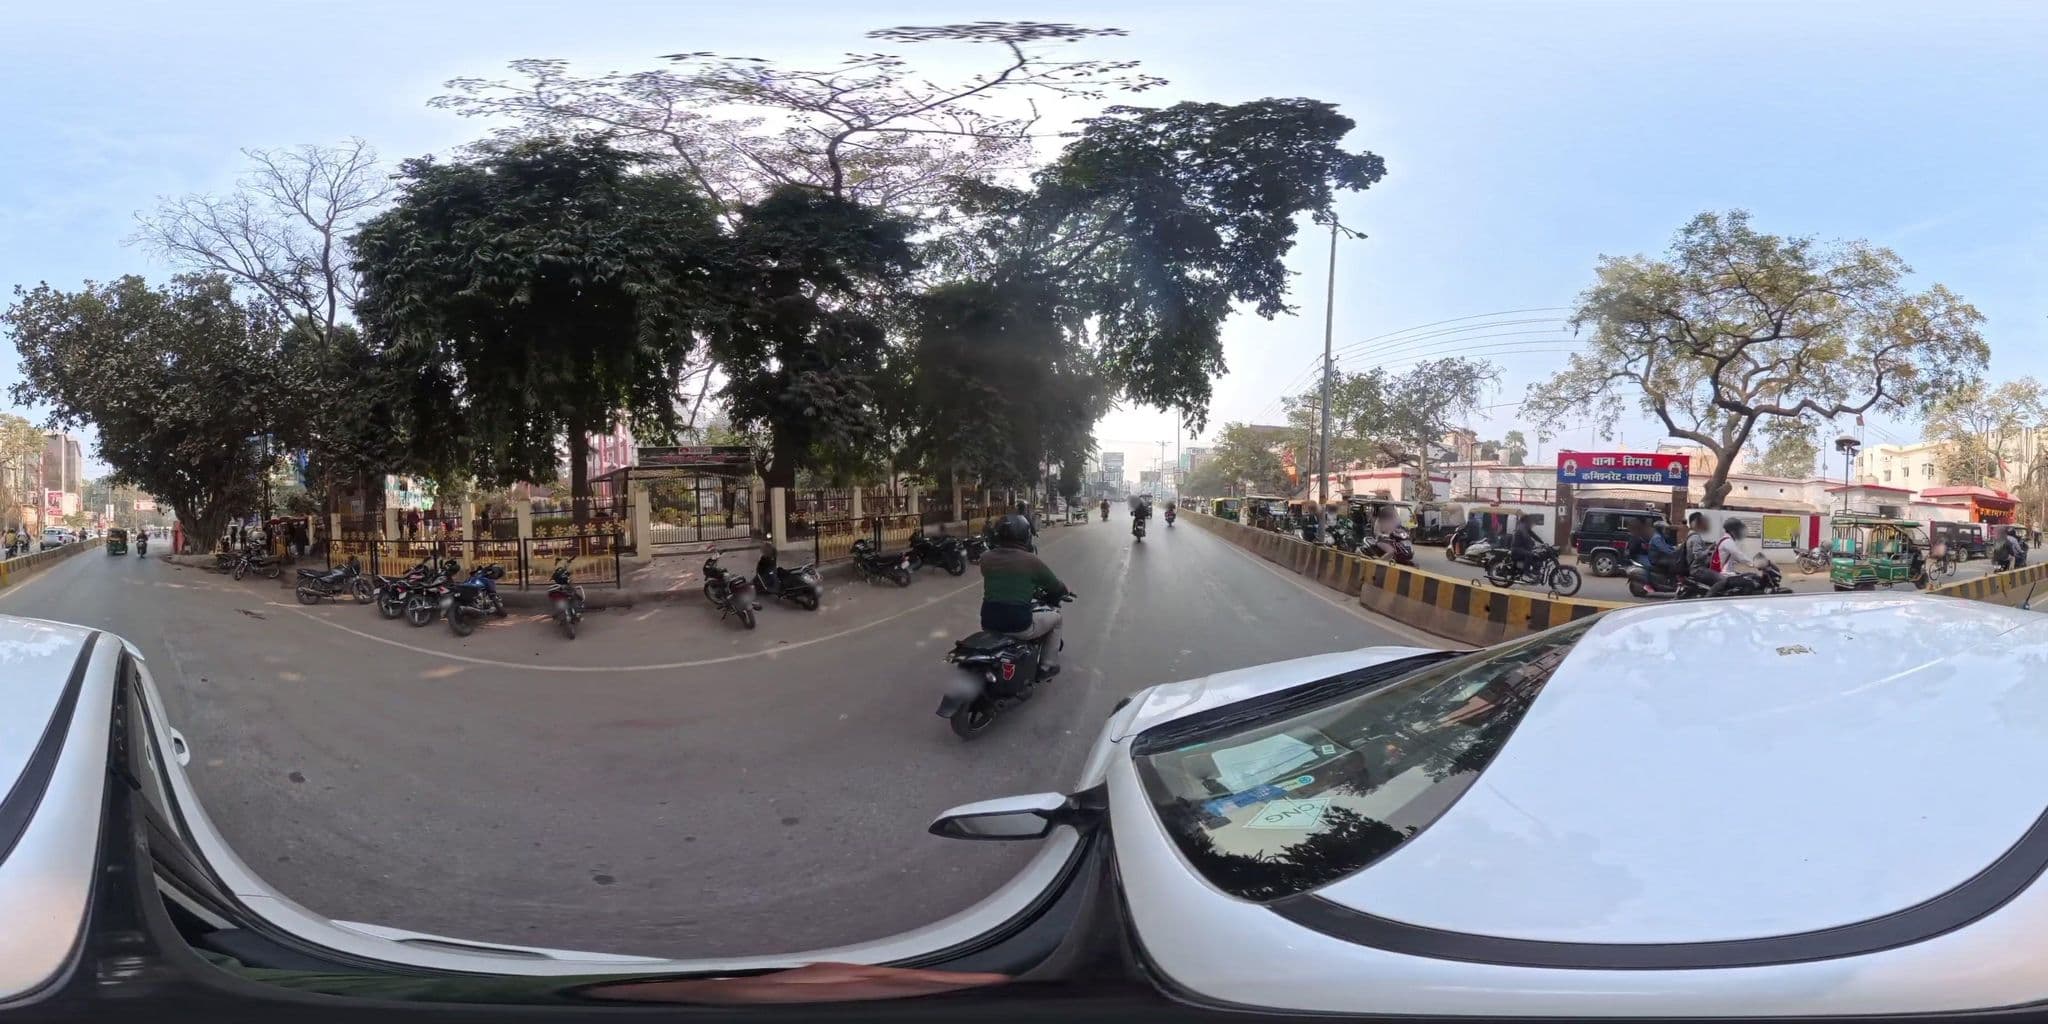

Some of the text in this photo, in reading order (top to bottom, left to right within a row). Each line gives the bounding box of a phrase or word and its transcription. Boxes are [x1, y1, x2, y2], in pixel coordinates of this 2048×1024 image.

[1592, 457, 1615, 466] थाना
[1623, 456, 1653, 467] सिगरा
[1265, 803, 1315, 824] CNG
